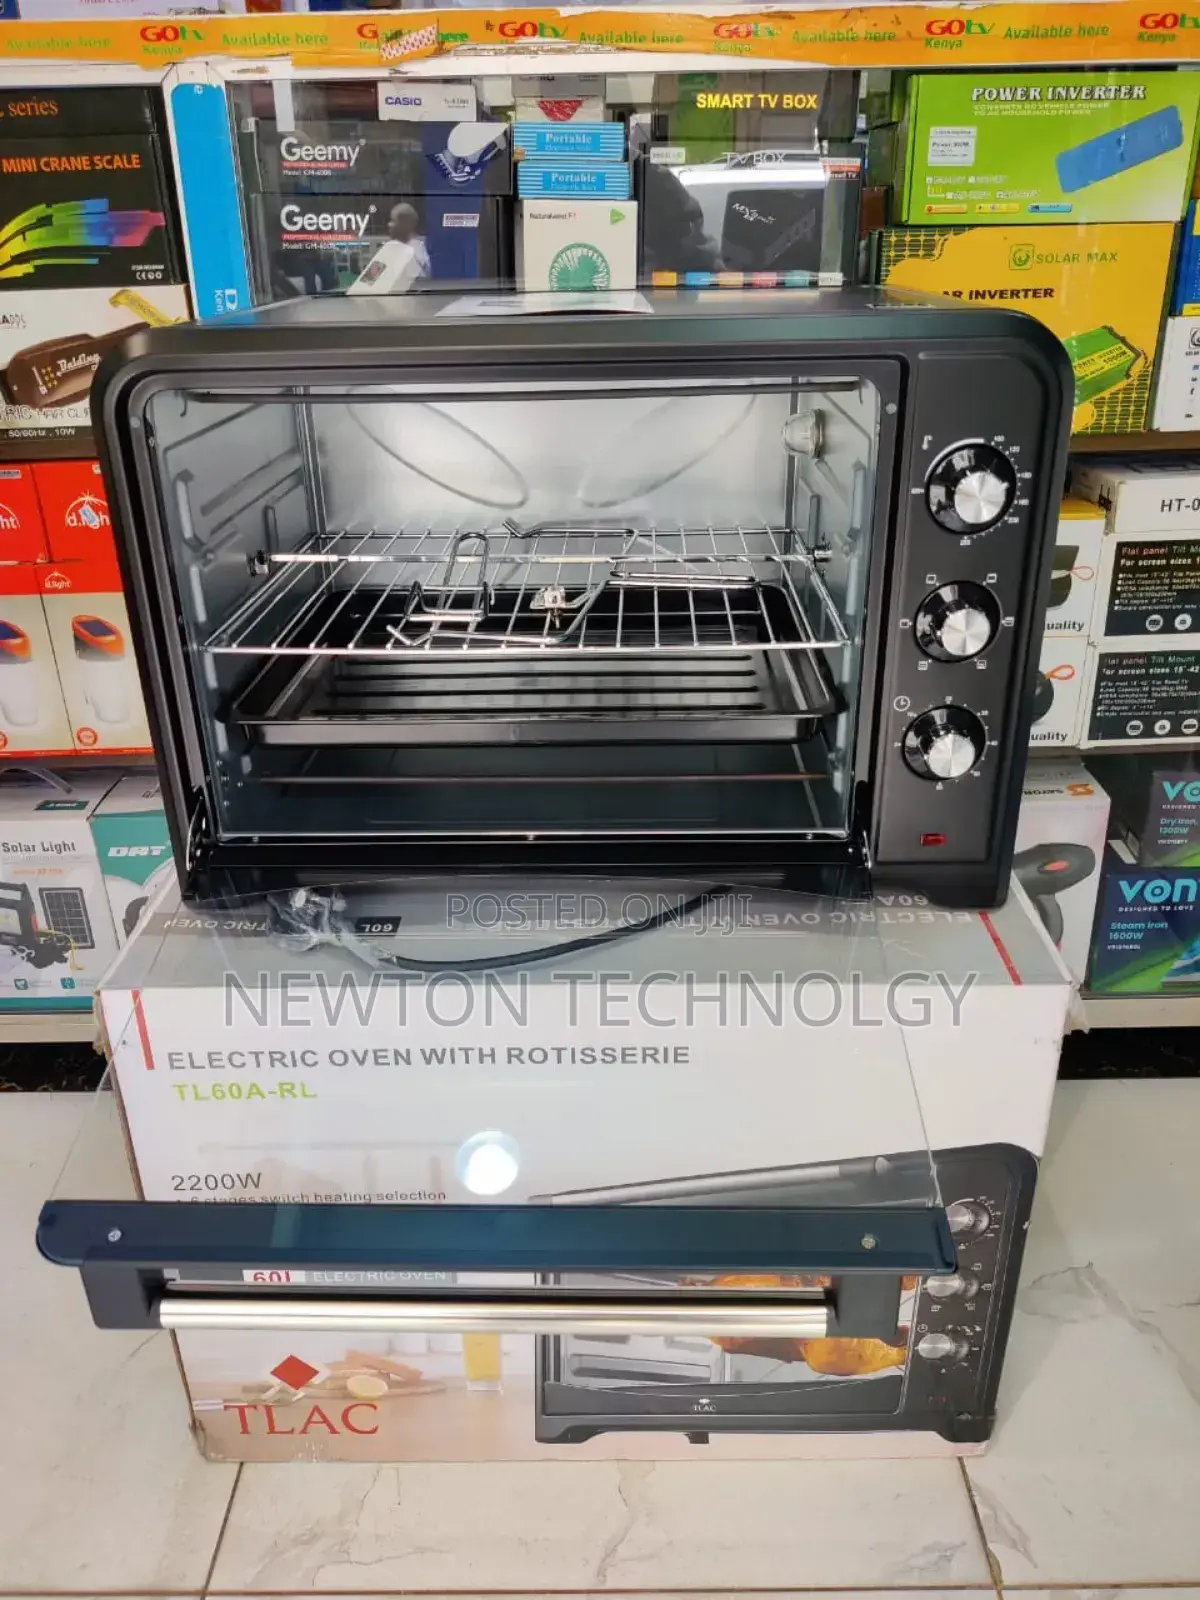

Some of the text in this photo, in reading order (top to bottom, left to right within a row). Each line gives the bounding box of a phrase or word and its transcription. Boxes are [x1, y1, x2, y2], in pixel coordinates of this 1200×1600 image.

[499, 21, 568, 38] GOtv
[925, 19, 995, 35] GOtv
[1003, 24, 1110, 40] Available here
[222, 32, 328, 46] Available here
[579, 30, 684, 44] Available here
[793, 30, 896, 42] Available here
[1138, 31, 1177, 43] Kenya
[925, 38, 963, 50] Kenya
[972, 86, 1147, 101] POWER INVERTER
[8, 97, 59, 117] series
[385, 96, 422, 106] CASIO
[696, 93, 818, 109] SMART TV BOX
[545, 133, 592, 144] Portable
[280, 136, 361, 166] Geemy
[3, 154, 141, 173] MINI CRANE SCALE
[551, 173, 597, 183] Portable
[280, 204, 370, 237] Geemy
[1036, 251, 1118, 264] SOLAR MAX
[969, 287, 1055, 300] INVERTER
[1046, 620, 1085, 632] uality
[1168, 655, 1195, 664] Mount
[1031, 731, 1068, 742] uality
[1, 839, 76, 856] Solar Light
[164, 919, 218, 930] OVEN
[749, 912, 821, 926] OVEN
[830, 911, 973, 925] ELECTRIC
[361, 922, 395, 932] 60L
[1110, 921, 1145, 931] Steam
[167, 1044, 690, 1071] ELECTRIC OVEN WITH ROTISSERIE
[171, 1081, 318, 1102] TL60A-RL
[170, 1171, 263, 1192] 2200W
[313, 1190, 373, 1204] heating
[375, 1189, 447, 1202] selection
[313, 1270, 397, 1283] ELECTRIC
[399, 1270, 447, 1283] OVEN
[222, 1402, 380, 1436] TLAC
